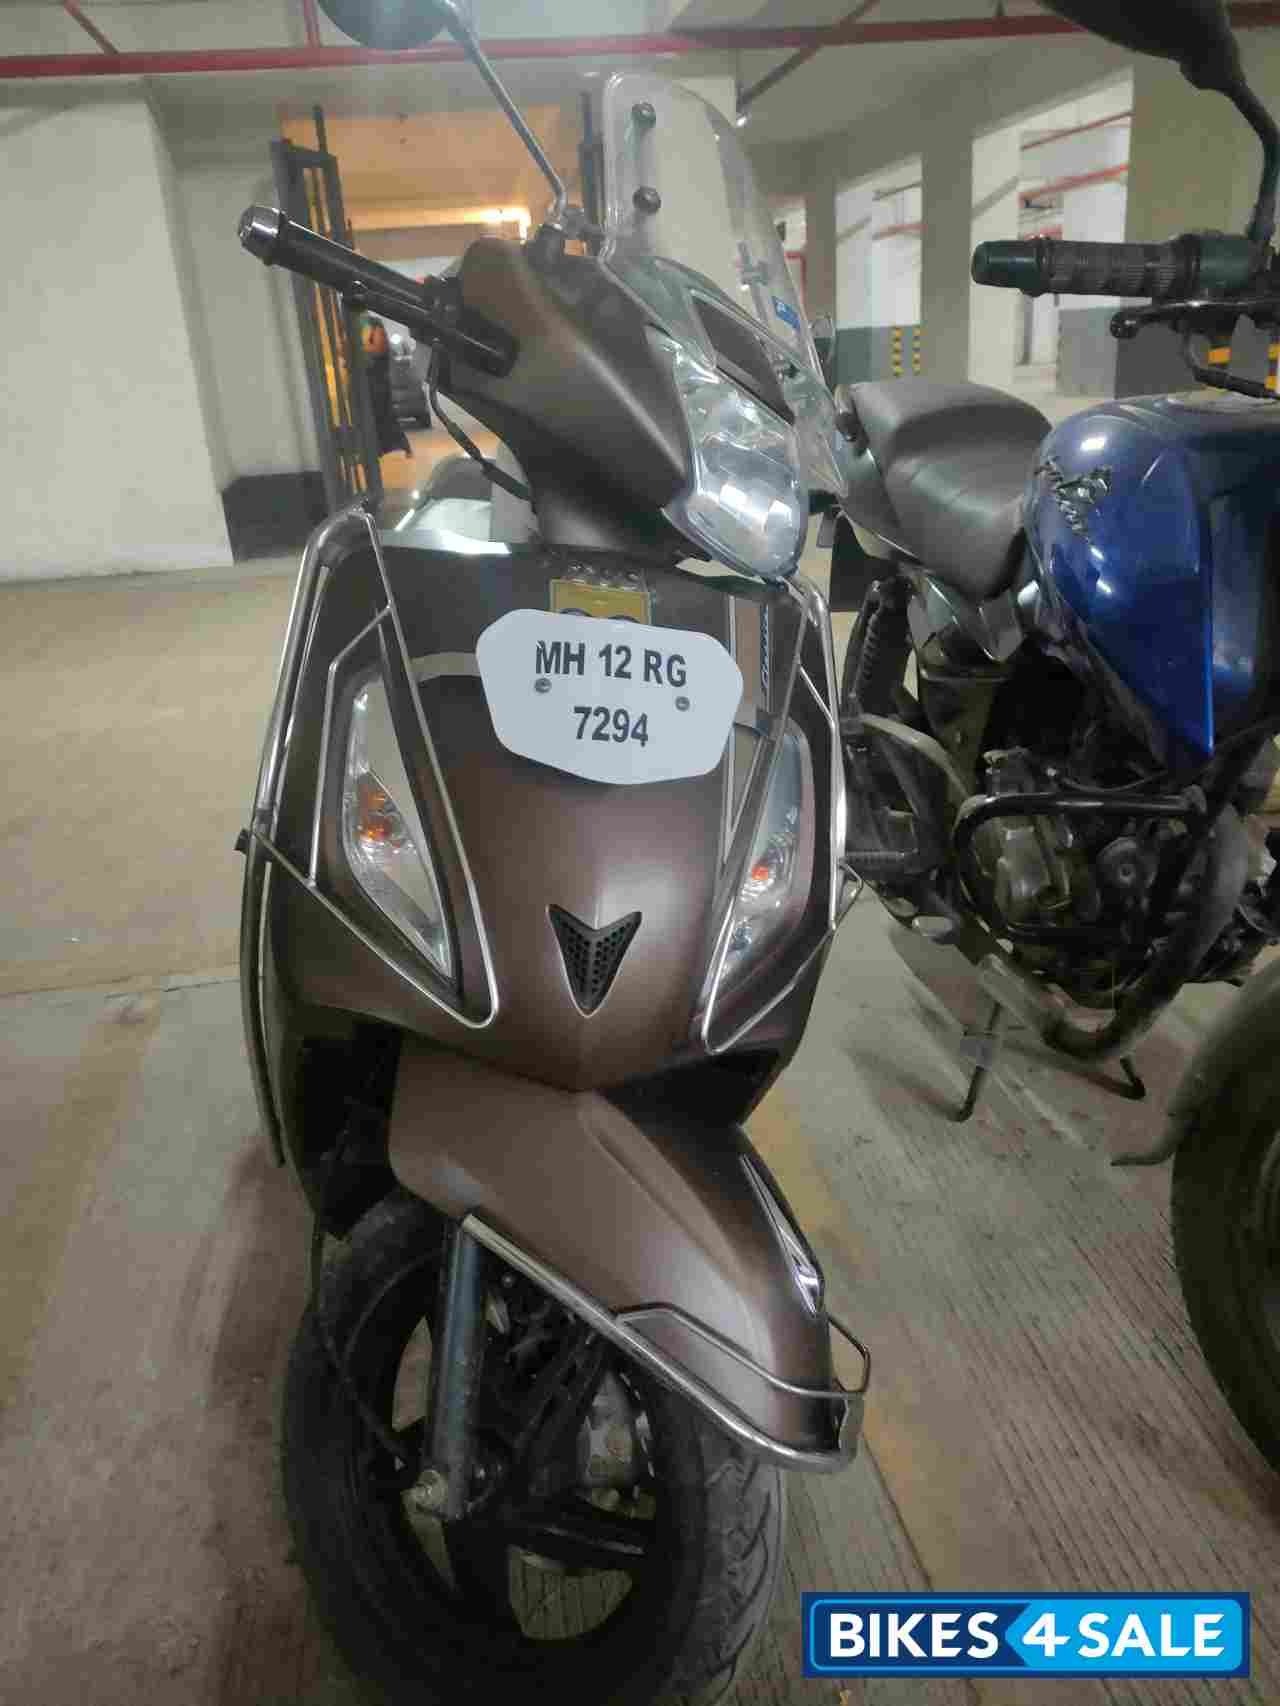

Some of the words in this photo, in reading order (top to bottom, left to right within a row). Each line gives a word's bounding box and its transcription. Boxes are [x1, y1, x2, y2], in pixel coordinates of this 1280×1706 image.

[535, 640, 586, 676] MH
[598, 643, 632, 680] 12
[643, 649, 688, 688] RG
[573, 706, 649, 747] 7294
